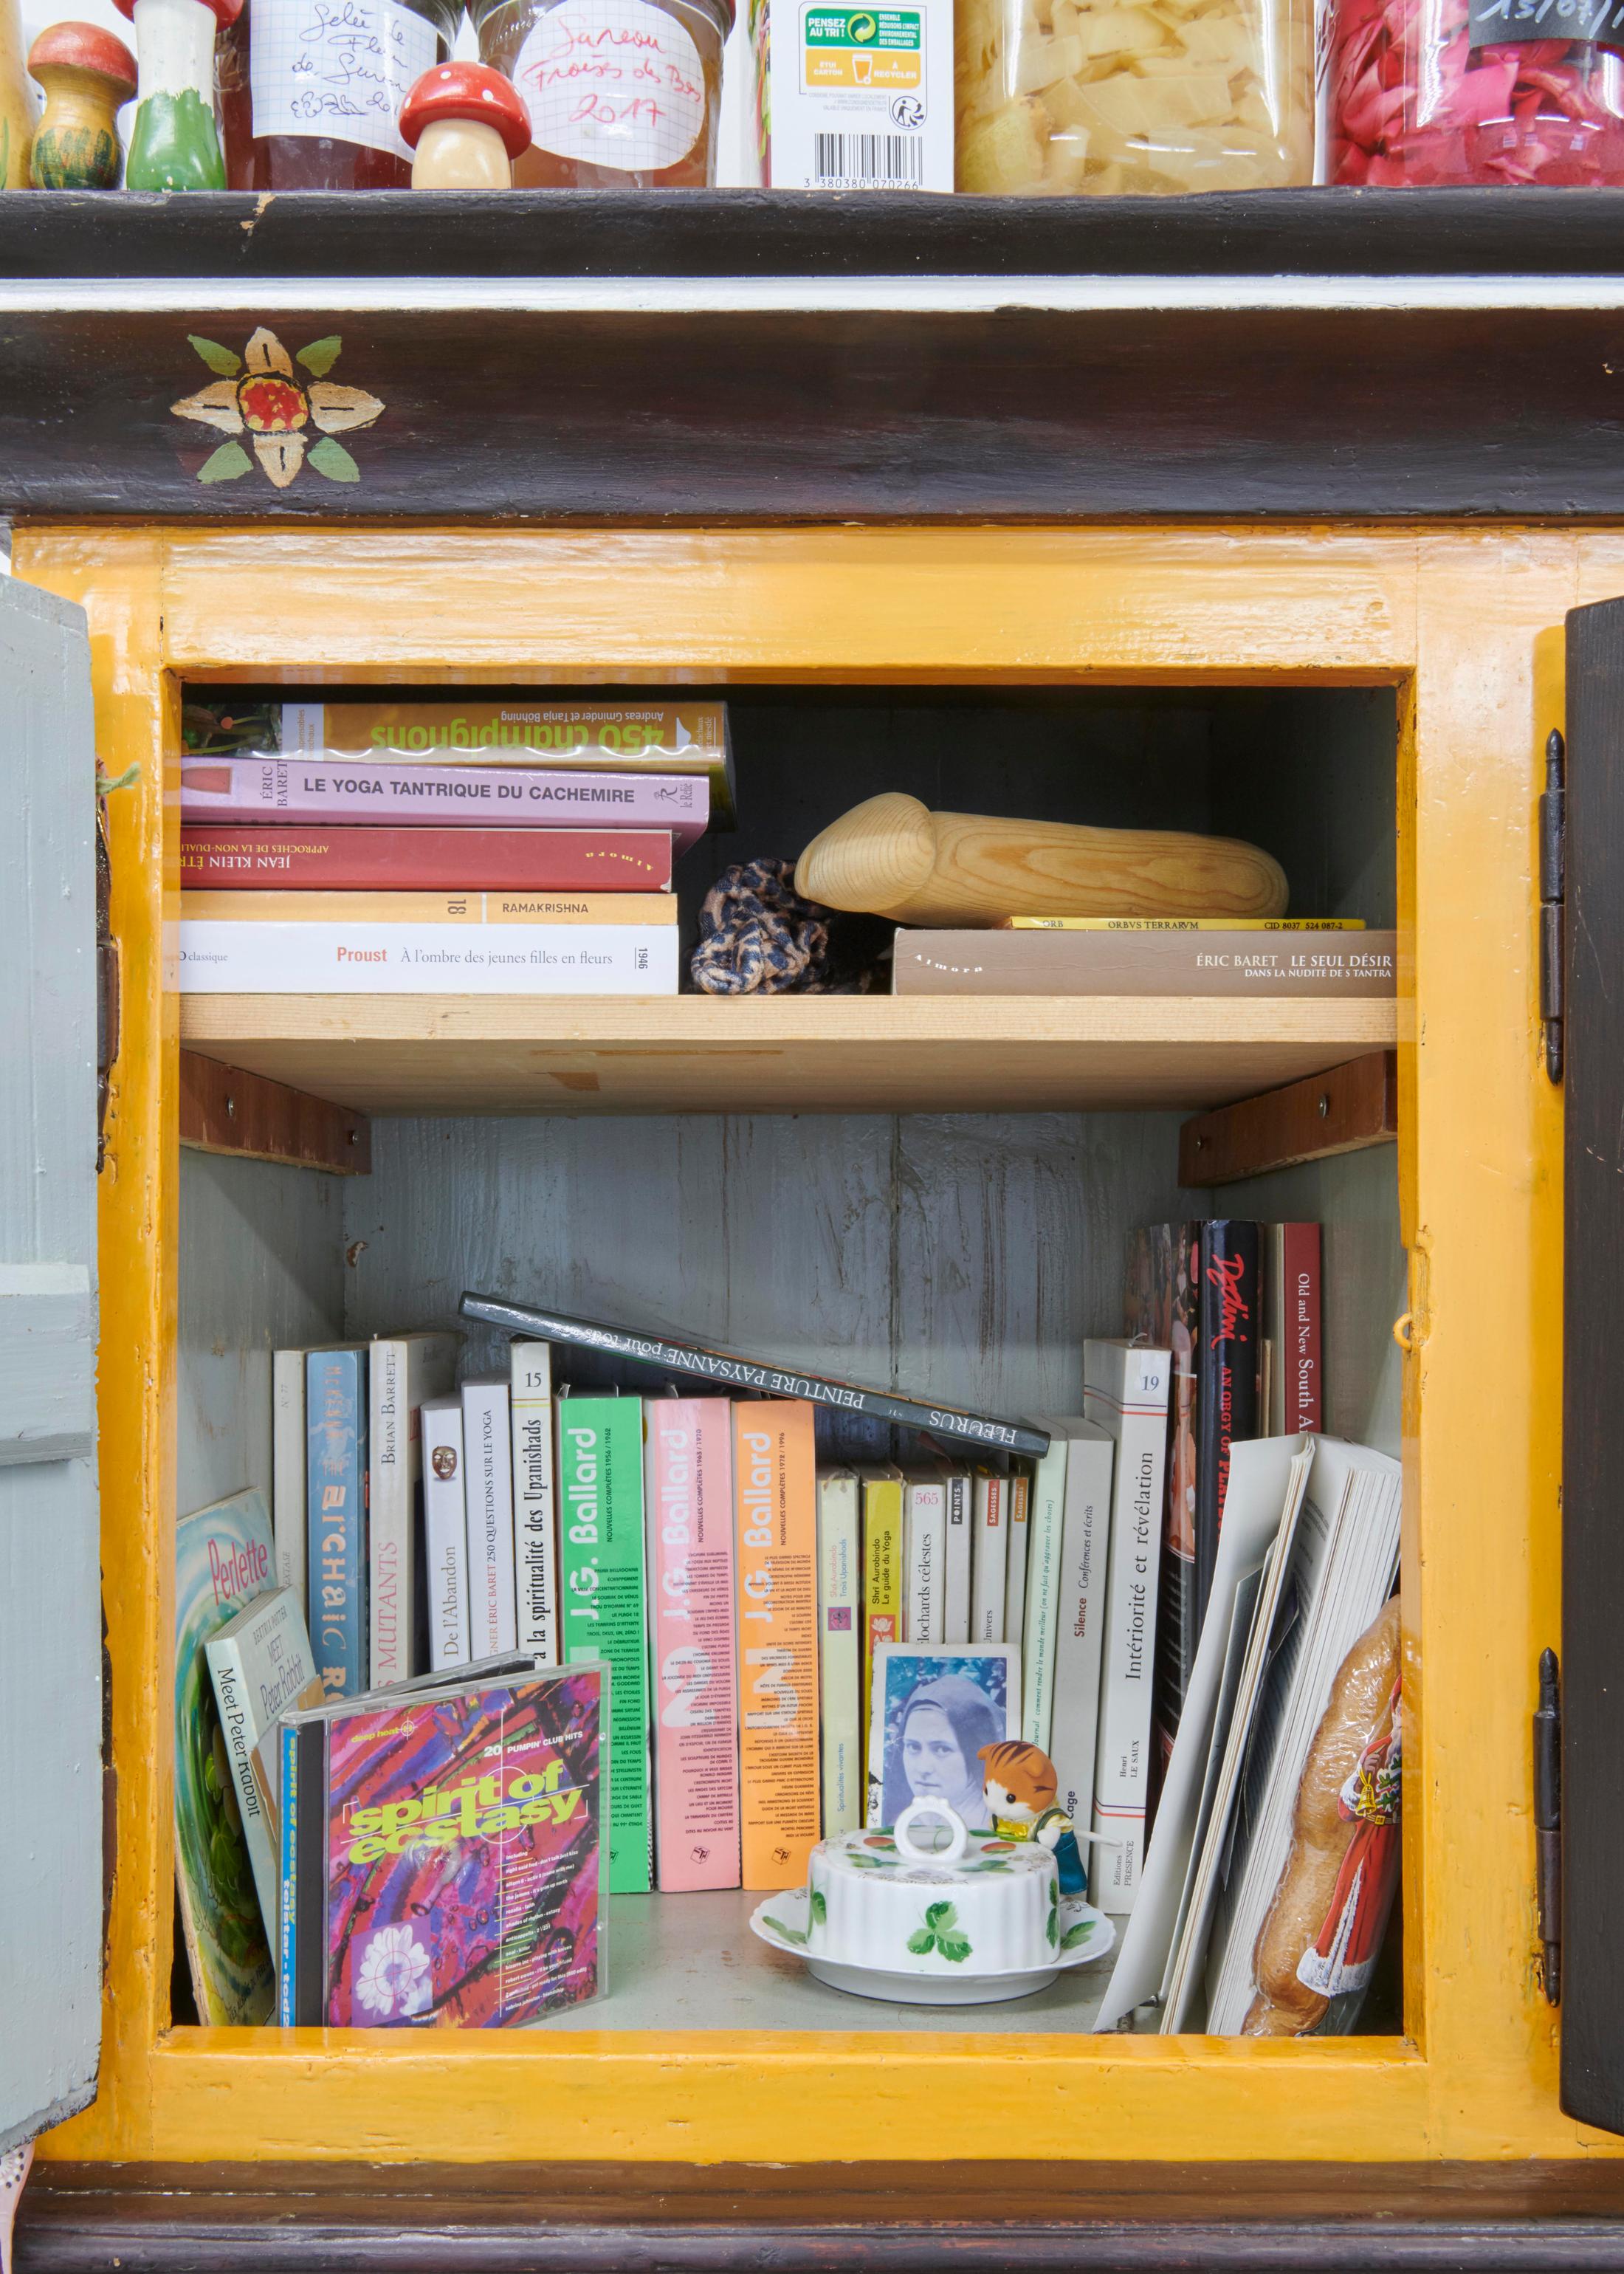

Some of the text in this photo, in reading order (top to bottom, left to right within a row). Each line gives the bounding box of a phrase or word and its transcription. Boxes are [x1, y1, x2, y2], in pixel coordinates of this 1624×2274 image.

[808, 18, 846, 28] PENSEZ
[809, 28, 839, 38] AU TRI
[568, 94, 667, 128] 2017
[501, 710, 664, 723] Andreas Gminder et Tanja Böhning
[371, 718, 664, 755] 450 champignons
[259, 766, 273, 800] ÉRIC
[277, 760, 288, 807] BARET
[303, 777, 635, 803] LE YOGA TANTRIQUE DU CACHEMIRE
[210, 856, 291, 869] JEAN KLEIN
[241, 844, 329, 853] APPROCHES DE LA
[447, 899, 467, 915] 18
[502, 903, 589, 913] RAMAKRISHNA
[1042, 920, 1064, 928] ORB
[1108, 921, 1142, 929] ORBVS
[1145, 921, 1199, 930] TERRARVM
[188, 951, 229, 962] classique
[337, 947, 388, 962] Proust
[401, 947, 411, 963] À
[464, 950, 484, 963] des
[487, 952, 526, 968] jeunes
[530, 950, 557, 963] filles
[562, 954, 575, 963] en
[579, 950, 613, 964] fleurs
[638, 948, 648, 969] 1946
[914, 954, 983, 973] Almora
[1196, 952, 1392, 967] ÉRIC BARET LE SEUL DÉSIR
[1245, 967, 1391, 978] DANS LA NUDITÉ TANTRA
[625, 1337, 664, 1356] pour
[1298, 1273, 1315, 1409] Old and New South
[525, 1373, 542, 1388] 15
[770, 1374, 865, 1409] PEINTURE
[1141, 1375, 1160, 1392] 19
[1221, 1367, 1233, 1387] AN
[929, 1411, 1018, 1445] FLEURUS
[1219, 1391, 1232, 1432] ORGY
[1219, 1435, 1231, 1454] OF
[568, 1428, 599, 1544] Ballard
[605, 1470, 613, 1504] COMPLÈTES
[660, 1429, 691, 1545] Ballard
[695, 1471, 703, 1505] COMPLÈTES
[743, 1432, 773, 1548] Ballard
[779, 1475, 787, 1508] COMPLÈTES
[915, 1492, 939, 1505] 565
[483, 1410, 498, 1625] ÉRIC BARET 250 QUESTIONS SUR LE YOGA
[953, 1487, 961, 1522] POINTS
[989, 1487, 997, 1524] SAGESSES
[522, 1419, 551, 1643] la spiritualité des Upanishads
[208, 1538, 268, 1607] Perlette
[830, 1545, 838, 1598] Shri Aurobindo
[839, 1539, 848, 1598] Trois Upanishads
[872, 1538, 881, 1605] Shri Aurobindo
[881, 1531, 892, 1605] Le guide du Yoga
[918, 1533, 932, 1581] célestes
[1074, 1505, 1093, 1638] Silence Conférences écrits
[1126, 1452, 1154, 1680] Intériorité et révélation
[1041, 1575, 1050, 1587] fait
[1043, 1588, 1048, 1596] ne
[378, 1541, 397, 1670] MUTANTS
[441, 1546, 459, 1657] De l'Abandon
[1039, 1610, 1047, 1636] meilleur
[266, 1634, 285, 1667] MEET
[260, 1653, 306, 1721] Peter Rabbit
[1036, 1666, 1044, 1686] rendre
[217, 1667, 249, 1757] Meet Peter
[484, 1731, 583, 1757] 20 PUMPIN' CLUB HITS
[1031, 1721, 1040, 1746] Journal
[1130, 1740, 1140, 1779] LE SAUX
[349, 1759, 564, 1836] spirit of
[289, 1737, 297, 1924] spirit of ecstasy
[348, 1789, 582, 1864] ecstasy
[1113, 1855, 1123, 1886] Editions
[1124, 1840, 1135, 1886] PRÉSENCE
